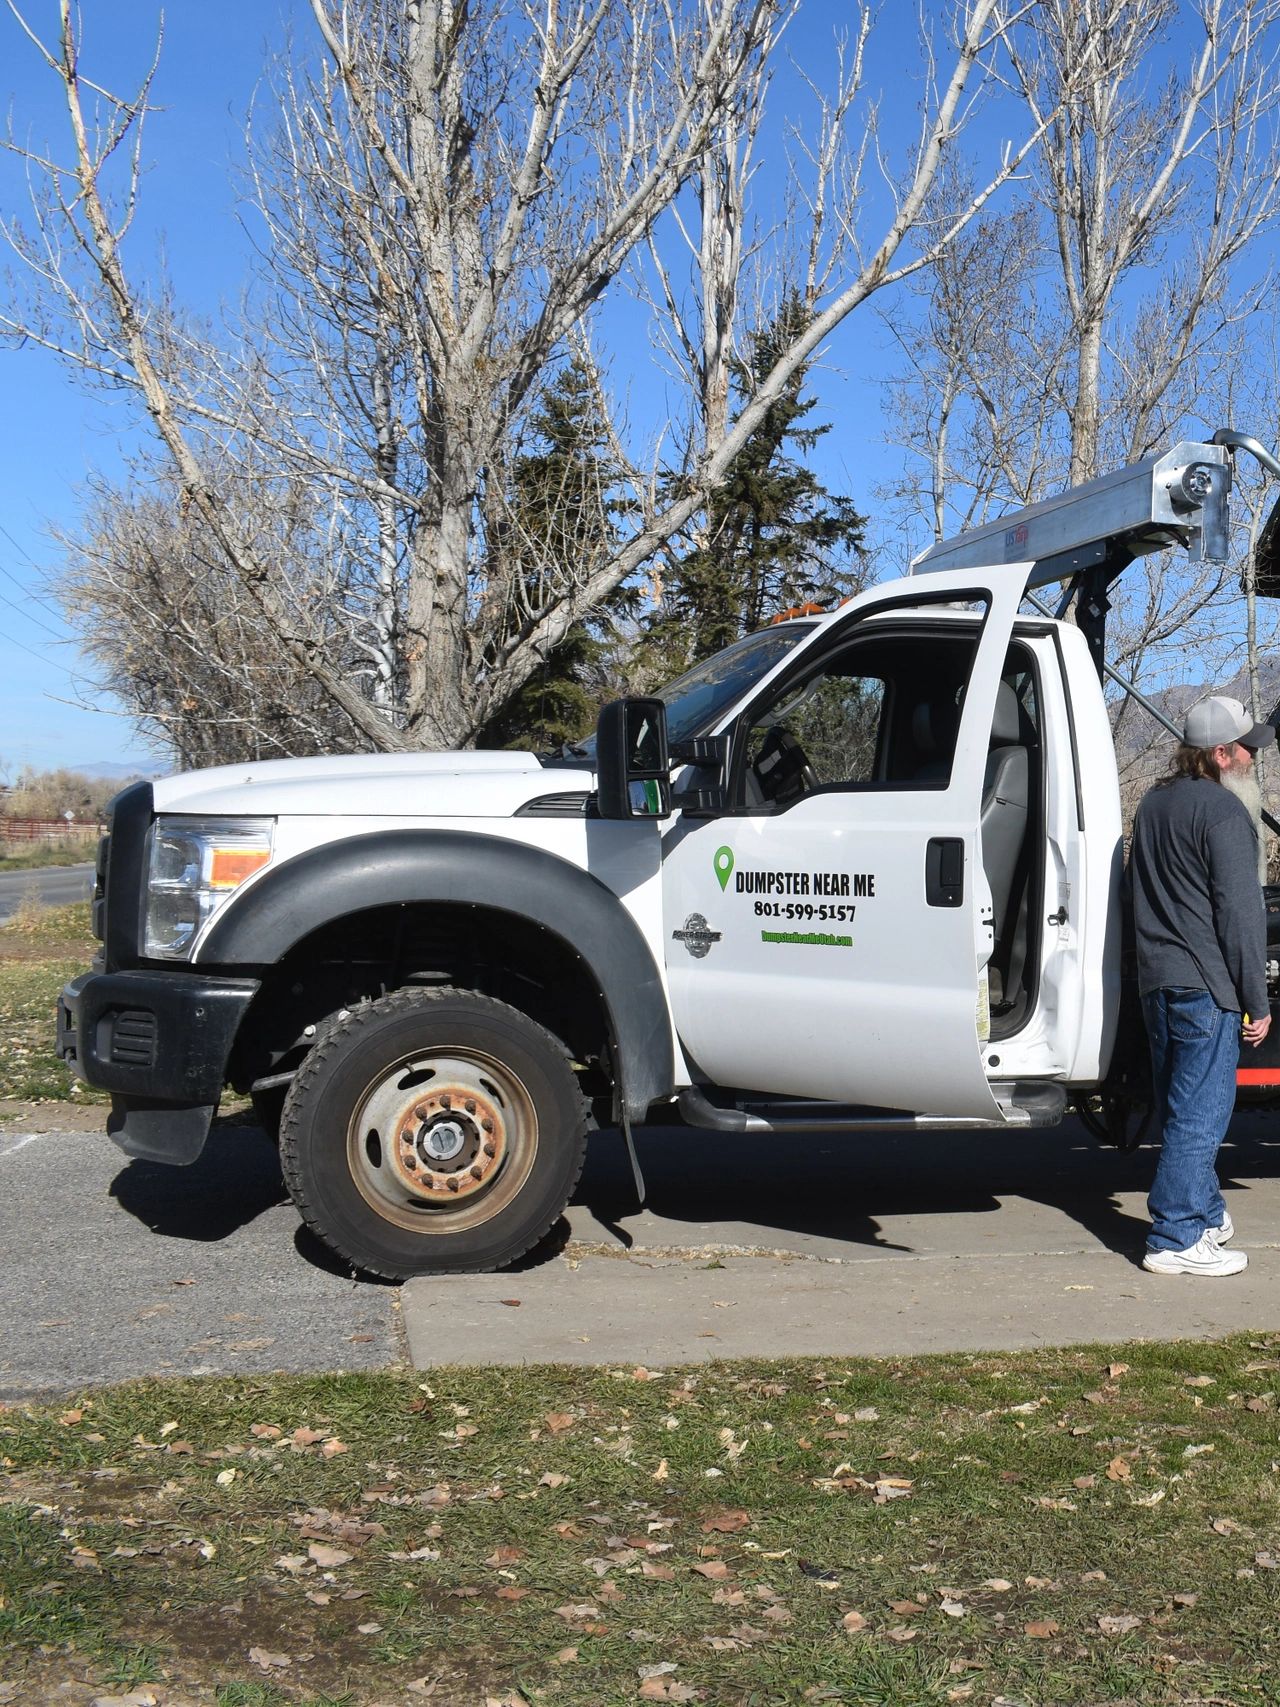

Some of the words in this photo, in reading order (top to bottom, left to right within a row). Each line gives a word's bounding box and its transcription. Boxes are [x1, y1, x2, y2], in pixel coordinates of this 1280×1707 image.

[735, 871, 810, 895] DUMPSTER
[813, 873, 850, 897] NEAR
[853, 874, 875, 897] ME
[754, 901, 856, 922] 801-599-5157
